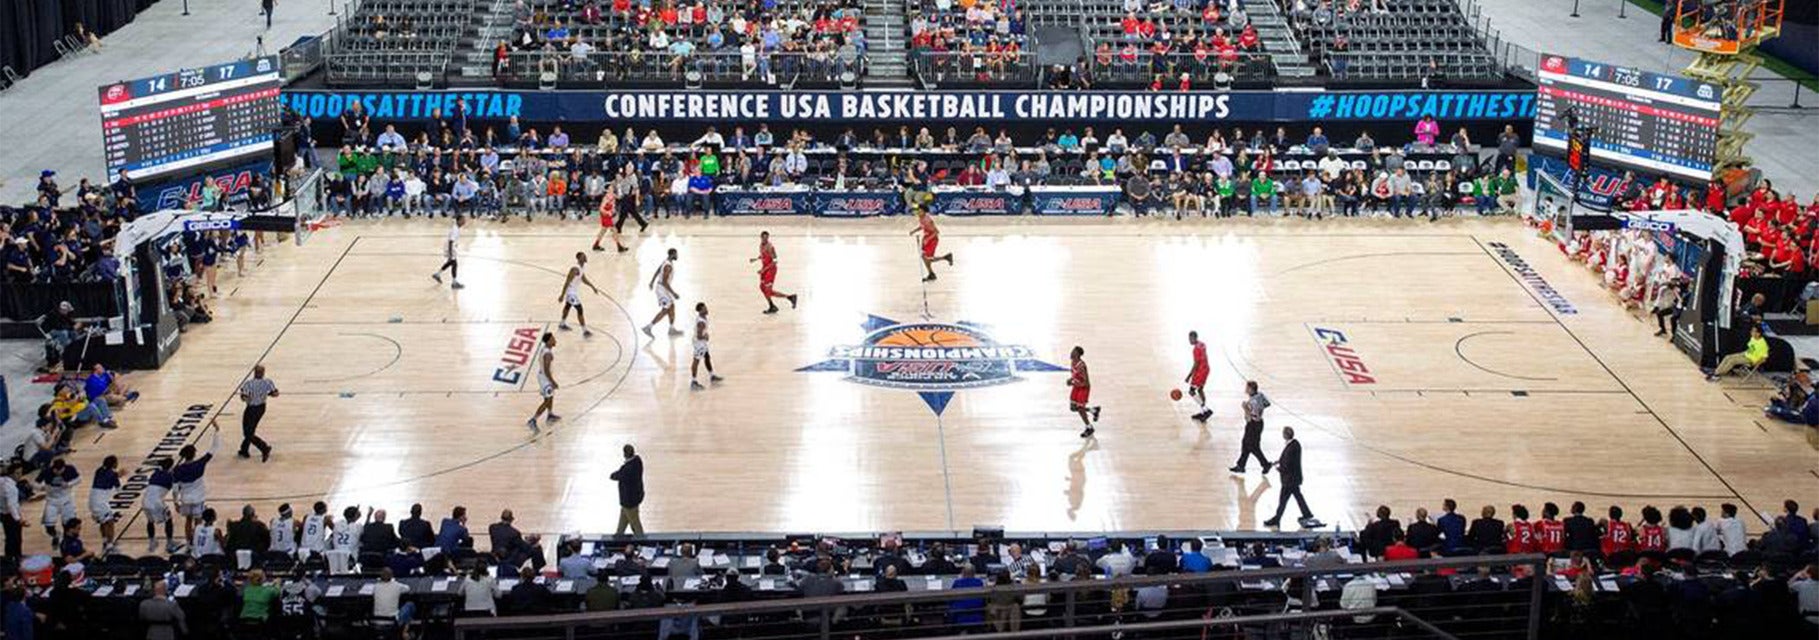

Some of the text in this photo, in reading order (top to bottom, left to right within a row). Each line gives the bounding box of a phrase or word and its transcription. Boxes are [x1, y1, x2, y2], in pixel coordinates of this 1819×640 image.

[219, 65, 235, 79] 17
[1584, 64, 1600, 77] 14
[149, 78, 166, 92] 14
[181, 76, 205, 88] 7:05
[1656, 77, 1673, 90] 17
[605, 94, 1230, 119] CONFERENCE USA BASKETBALL CHAMPIONSHIPS
[188, 220, 232, 231] GEICO
[1628, 219, 1670, 231] GEICO
[831, 345, 1034, 360] CHAMPIONSHIPS
[338, 533, 350, 545] 22
[1521, 531, 1530, 543] 2
[1613, 531, 1627, 543] 12
[1647, 534, 1661, 546] 14
